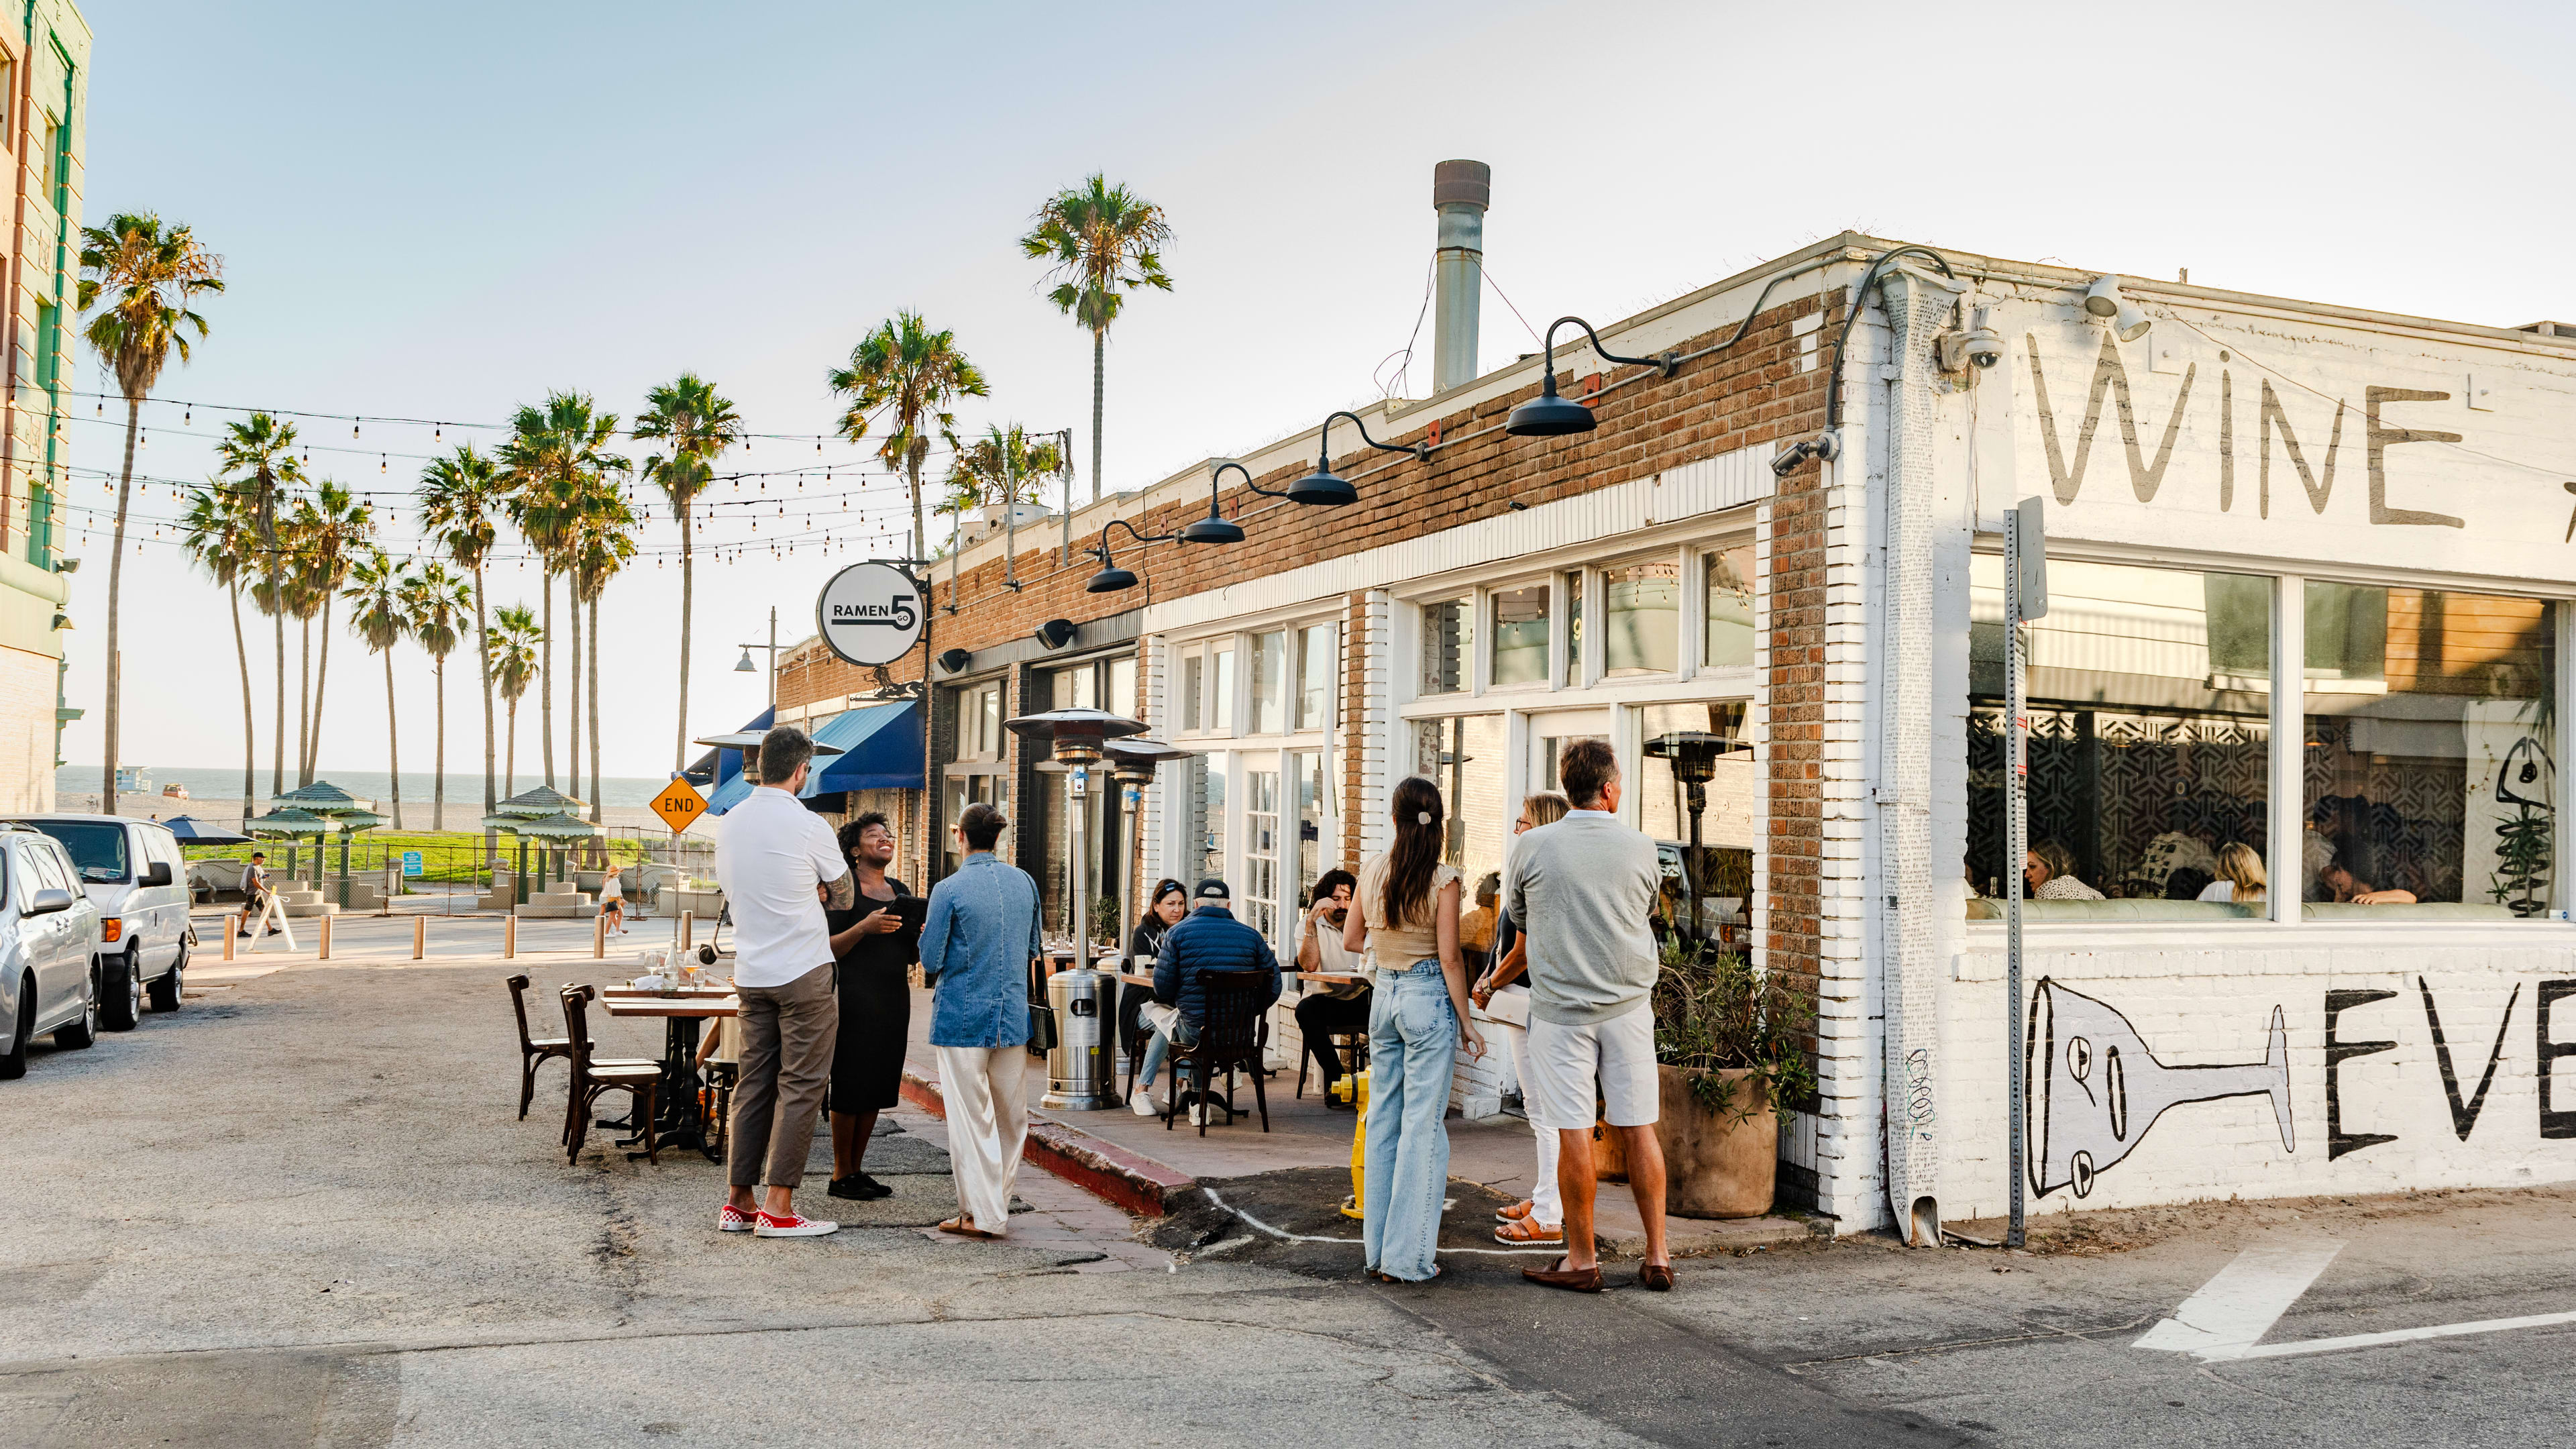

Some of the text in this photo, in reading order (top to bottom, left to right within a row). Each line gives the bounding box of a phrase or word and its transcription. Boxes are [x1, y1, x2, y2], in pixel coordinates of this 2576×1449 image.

[834, 595, 916, 631] RAMEN 5
[665, 798, 694, 812] END
